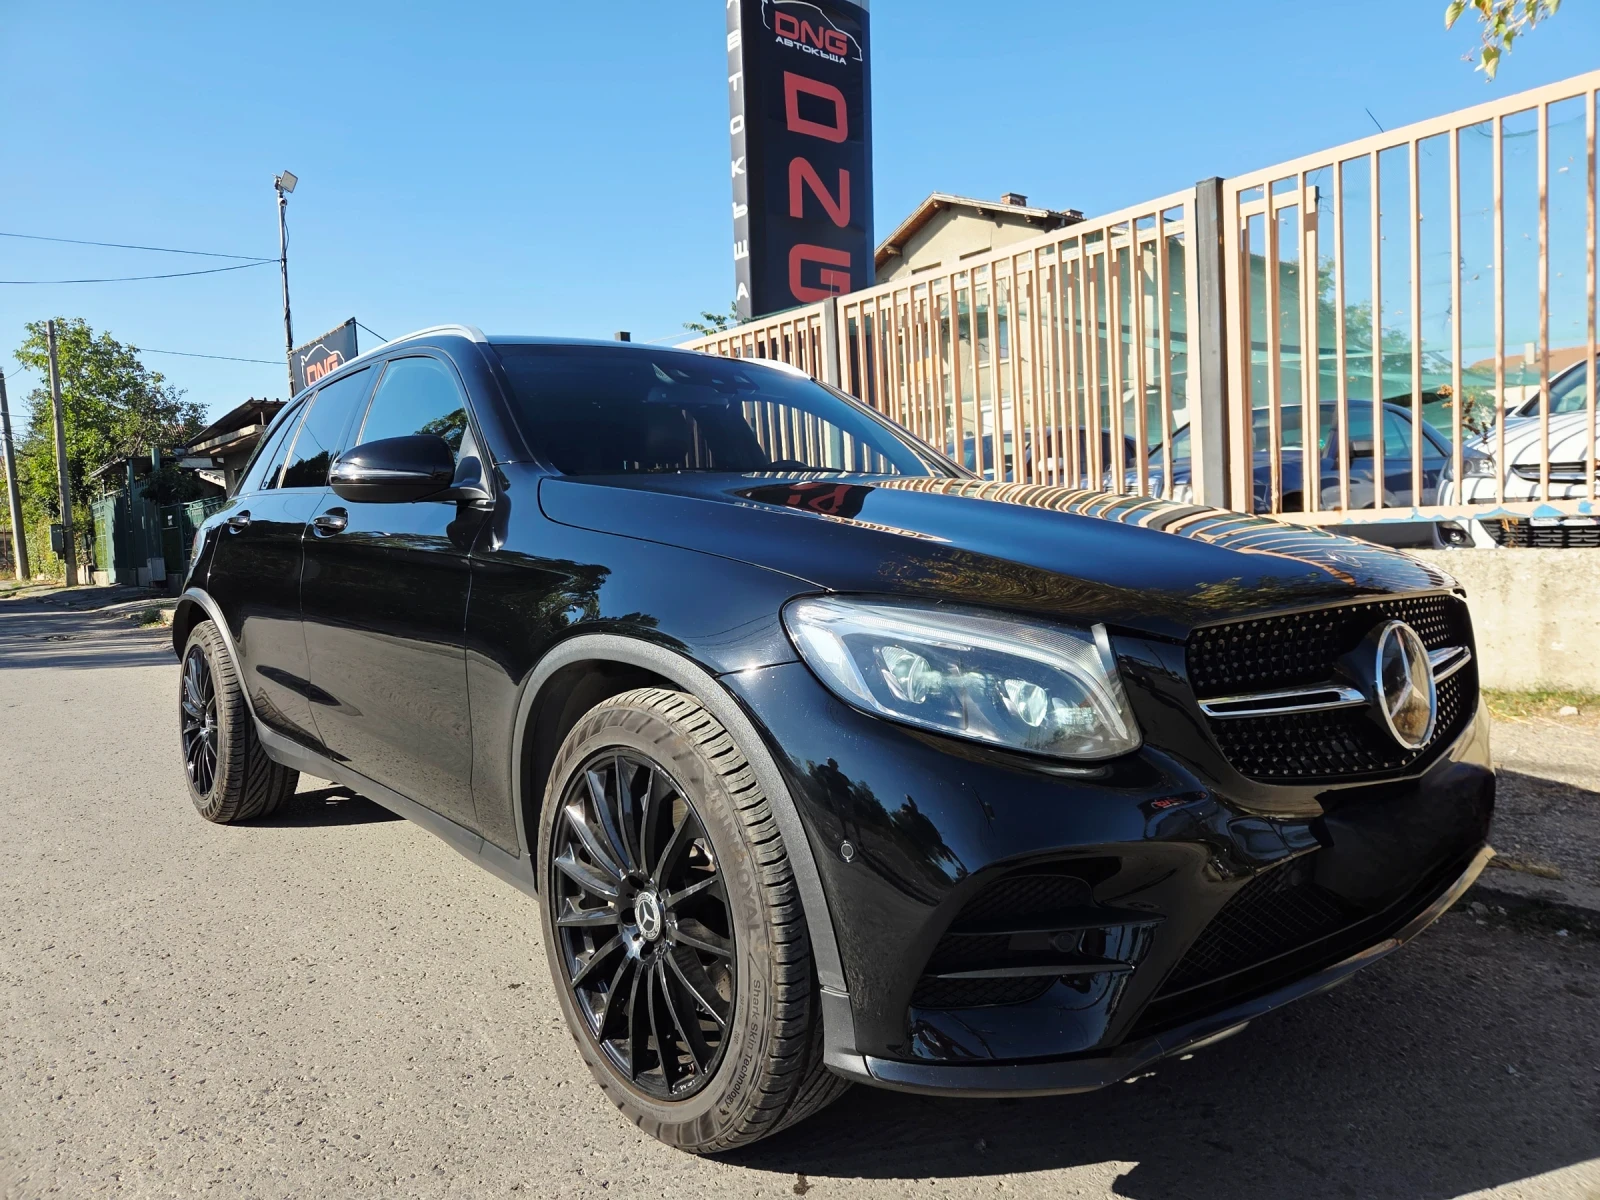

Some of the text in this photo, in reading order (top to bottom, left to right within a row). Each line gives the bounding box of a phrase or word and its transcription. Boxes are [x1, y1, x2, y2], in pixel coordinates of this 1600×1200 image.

[775, 10, 848, 56] DNG
[783, 70, 851, 303] DNG
[306, 353, 338, 386] DNG
[749, 979, 762, 1021] Shark
[743, 1021, 760, 1051] Skin
[724, 1052, 754, 1110] Technology
